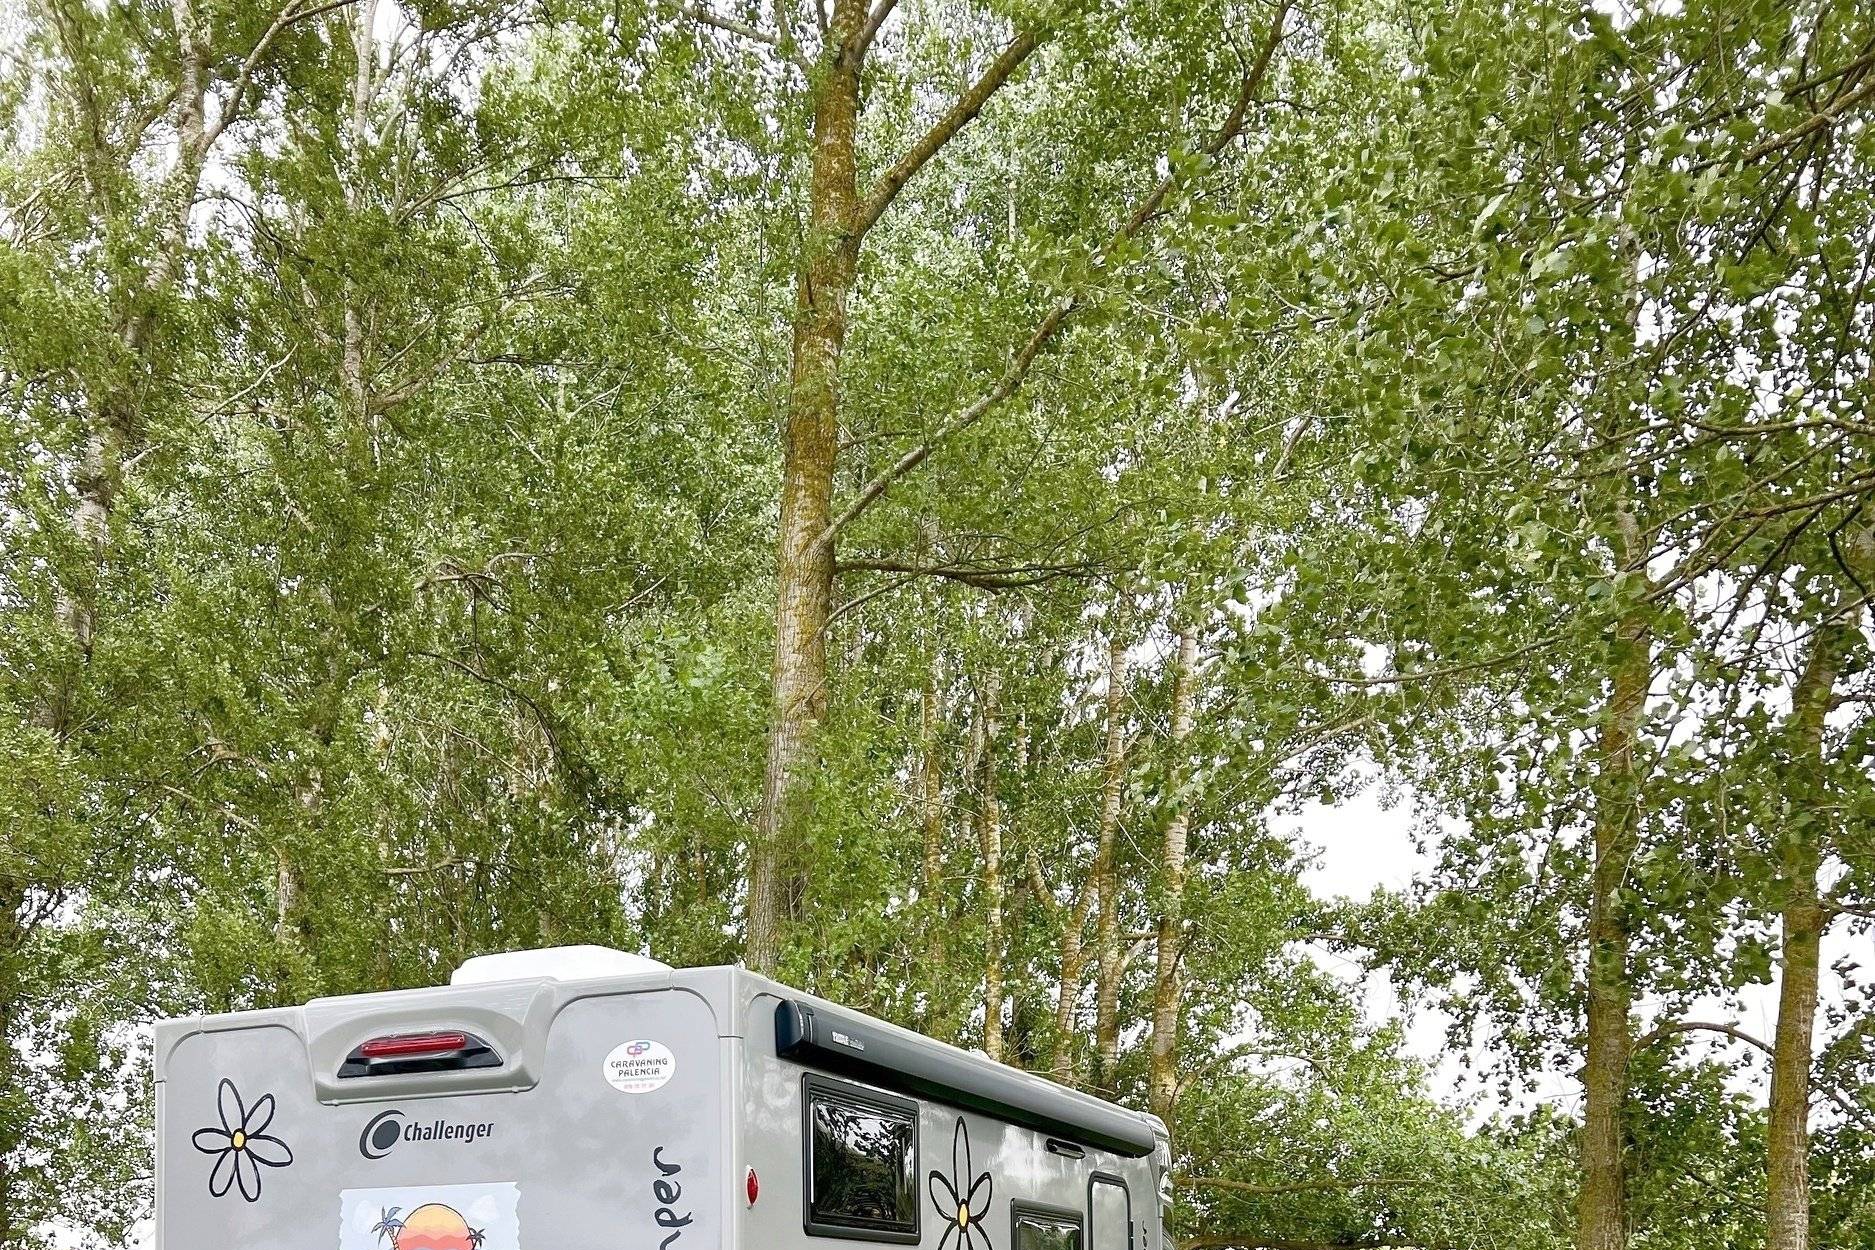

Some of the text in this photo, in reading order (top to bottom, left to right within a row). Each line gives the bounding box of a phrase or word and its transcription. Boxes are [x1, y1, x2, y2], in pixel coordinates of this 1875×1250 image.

[610, 1057, 668, 1069] CARAVANING
[618, 1067, 660, 1077] PALENCIA
[404, 1120, 495, 1144] Challenger
